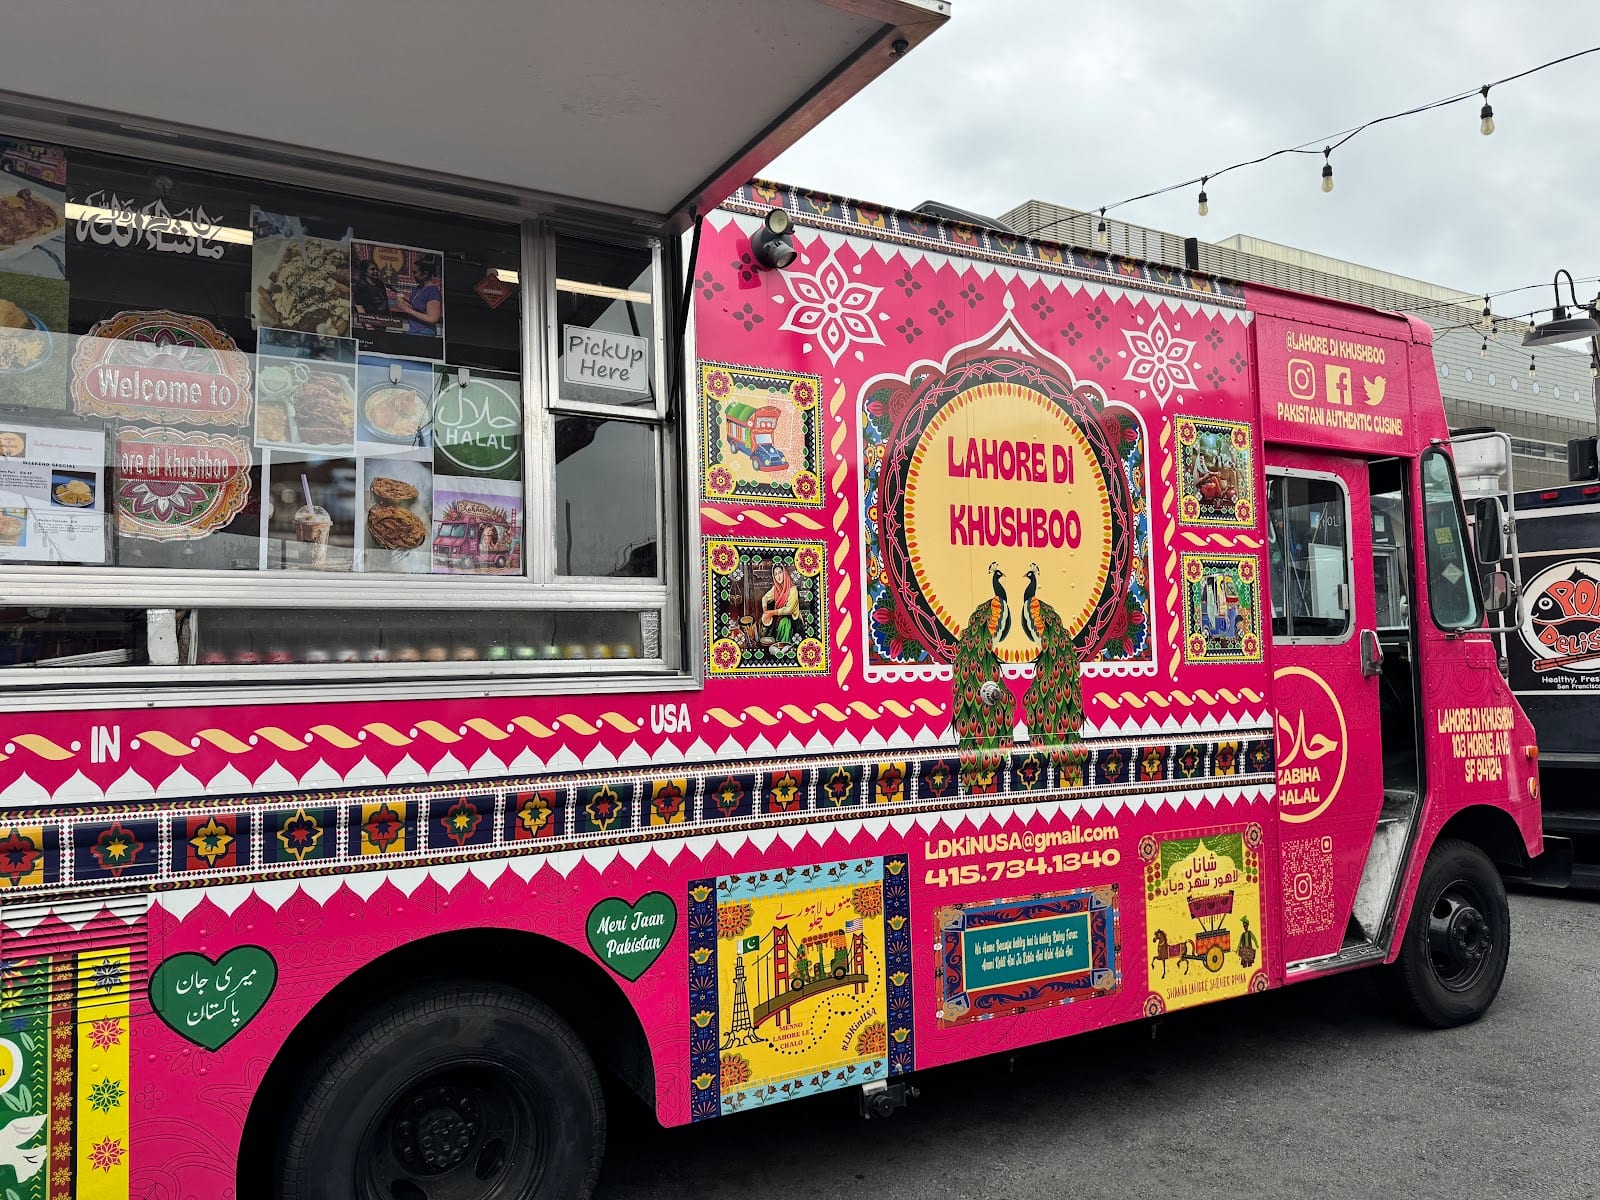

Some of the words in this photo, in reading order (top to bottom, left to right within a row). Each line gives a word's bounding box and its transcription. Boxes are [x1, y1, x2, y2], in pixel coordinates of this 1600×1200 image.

[1287, 331, 1328, 354] @LAHORE
[1328, 339, 1339, 357] DI
[1339, 341, 1385, 365] KHUSHBOO
[580, 359, 630, 381] Here
[98, 367, 202, 405] Welcome
[210, 379, 232, 406] to
[1277, 402, 1325, 426] PAKISTANI
[1326, 409, 1373, 432] AUTHENTIC
[1373, 415, 1403, 436] CUSINE
[446, 427, 512, 450] HALAL
[148, 447, 160, 476] di
[164, 449, 229, 479] khushboo
[948, 435, 1048, 483] LAHORE
[1052, 444, 1074, 485] DI
[949, 503, 1082, 550] KHUSHBOO
[1541, 675, 1577, 684] Healthy,
[650, 703, 692, 734] USA
[1438, 708, 1472, 733] LAHORE
[1472, 707, 1480, 732] DI
[91, 725, 121, 763] IN
[1452, 734, 1466, 759] 103
[1467, 732, 1494, 758] HORNE
[1495, 731, 1511, 756] AVE
[1465, 759, 1475, 783] SF
[1477, 757, 1502, 782] 94124
[1278, 787, 1320, 806] HALAL
[924, 848, 1121, 888] 415.734.1340
[596, 914, 628, 935] Meri
[631, 912, 665, 931] Jaan
[606, 935, 661, 959] Pakistan
[176, 970, 209, 995] جان
[772, 1031, 801, 1042] LAHORE
[779, 1021, 804, 1032] MENNO
[780, 1040, 804, 1049] CHALO
